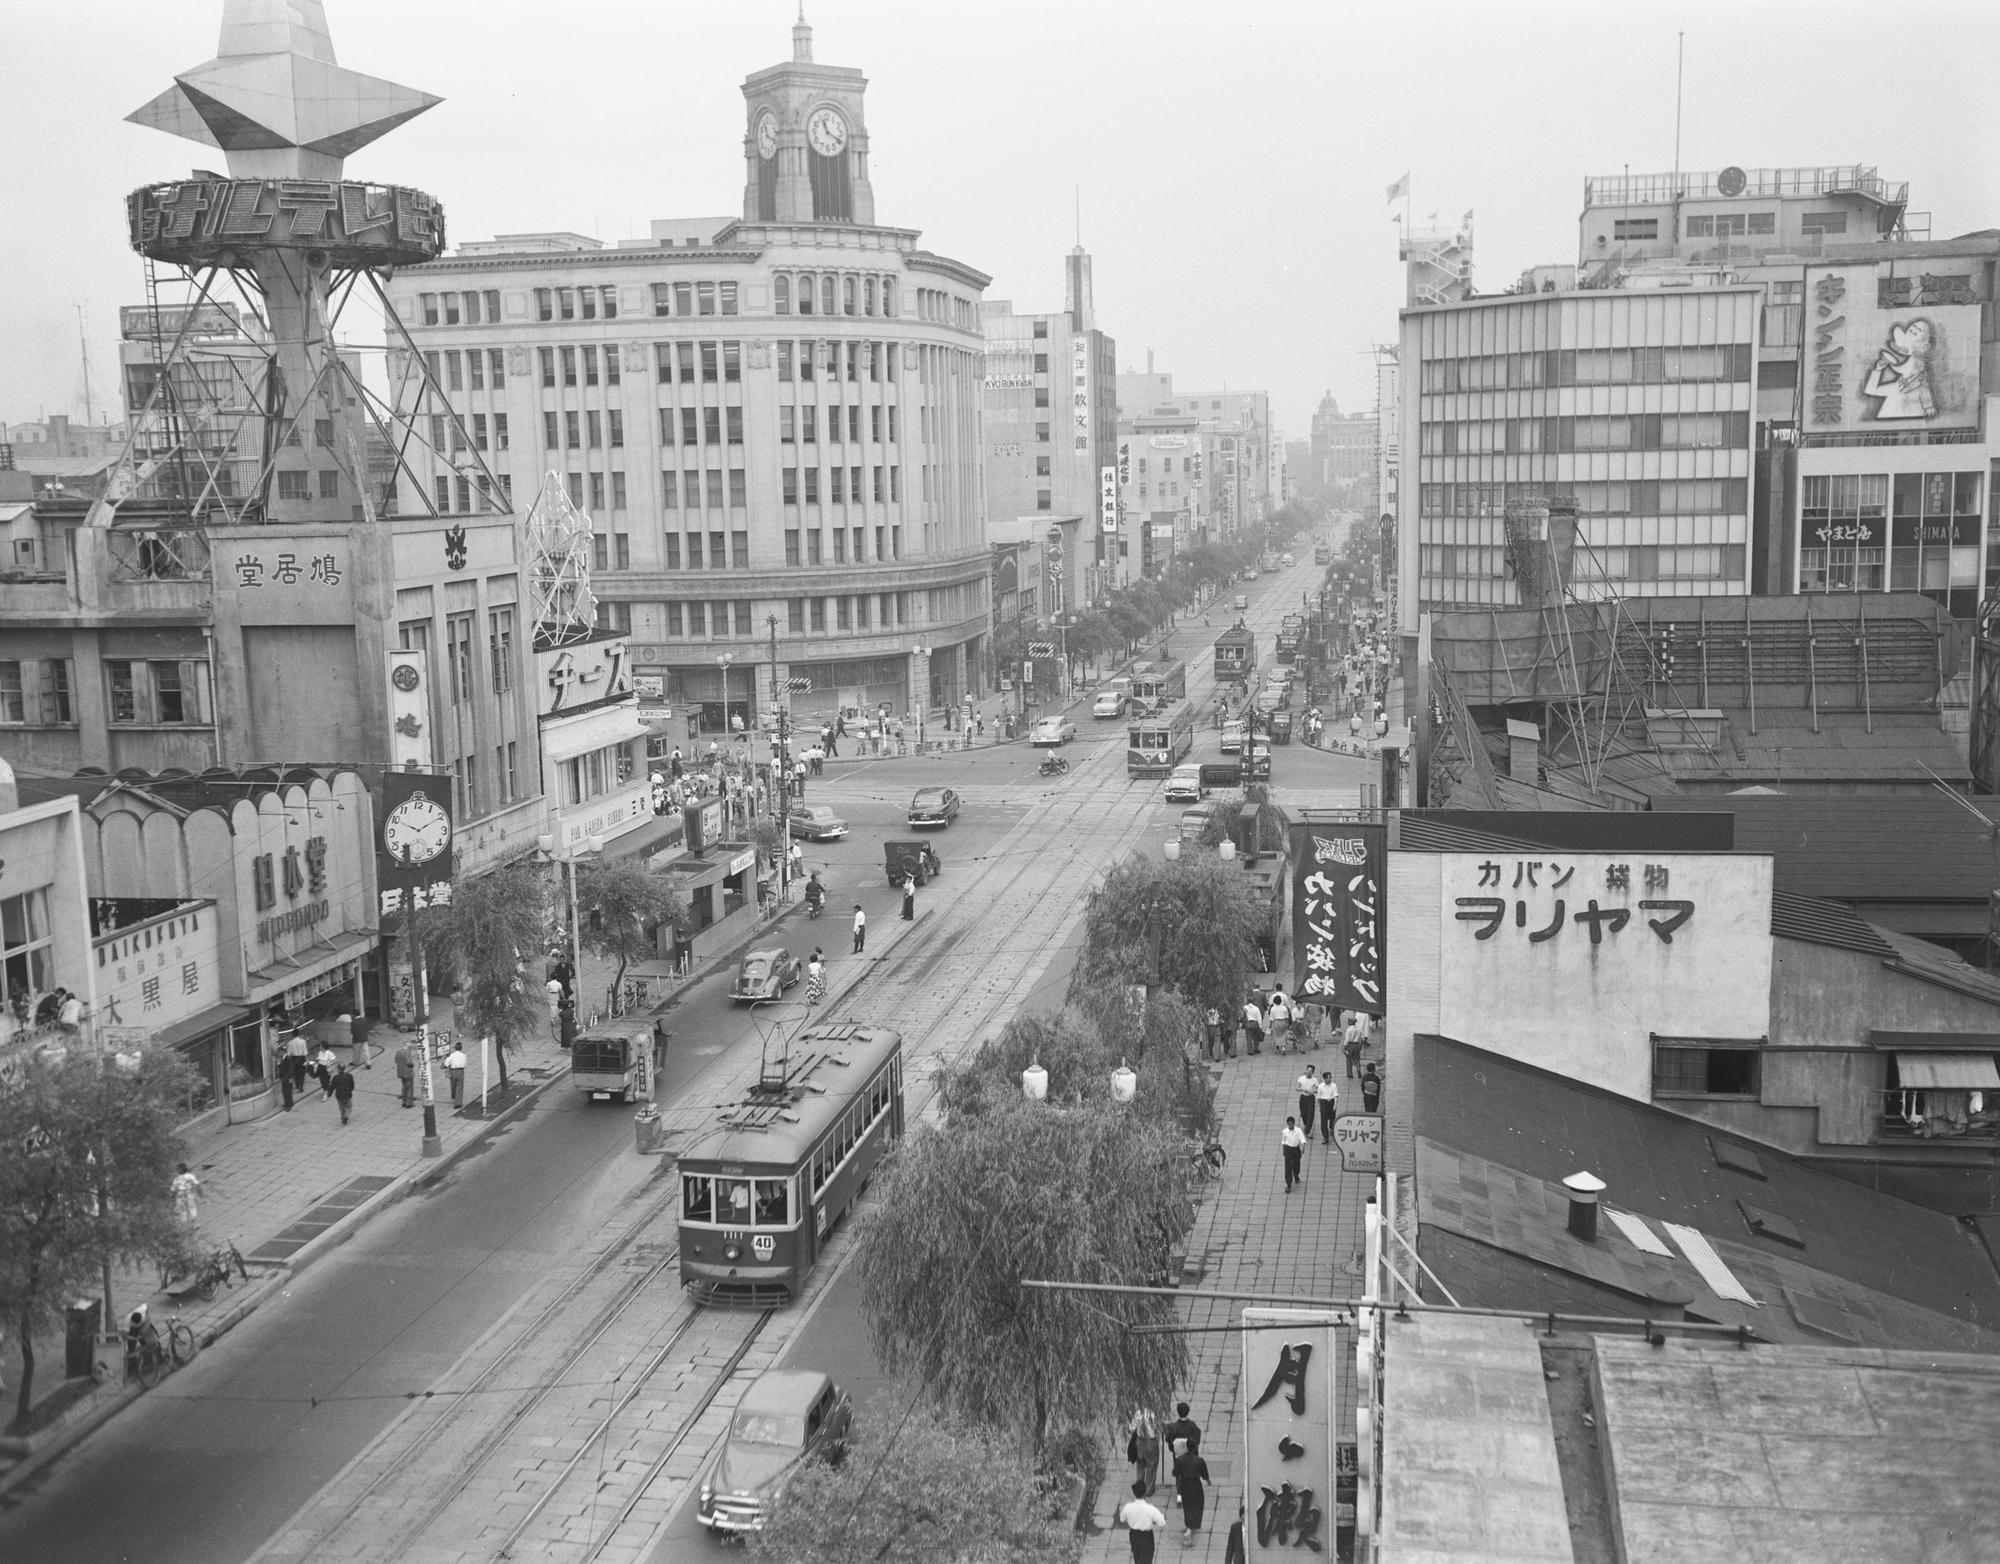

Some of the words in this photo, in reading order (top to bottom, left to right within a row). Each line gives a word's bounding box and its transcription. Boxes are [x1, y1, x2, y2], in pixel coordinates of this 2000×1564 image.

[1815, 273, 1846, 425] キンシ正宗
[1103, 472, 1116, 526] 住友銀行
[1816, 524, 1872, 541] やまと屋
[1913, 526, 1960, 541] SHIMAYA
[254, 836, 328, 913] 日本堂
[1477, 860, 1576, 889] カバン
[1605, 863, 1670, 891] 袋物
[1454, 897, 1696, 944] ヲリヤマ
[1345, 1119, 1376, 1128] カバン
[1338, 1129, 1381, 1144] ヲリヤマ
[755, 1237, 772, 1249] 40
